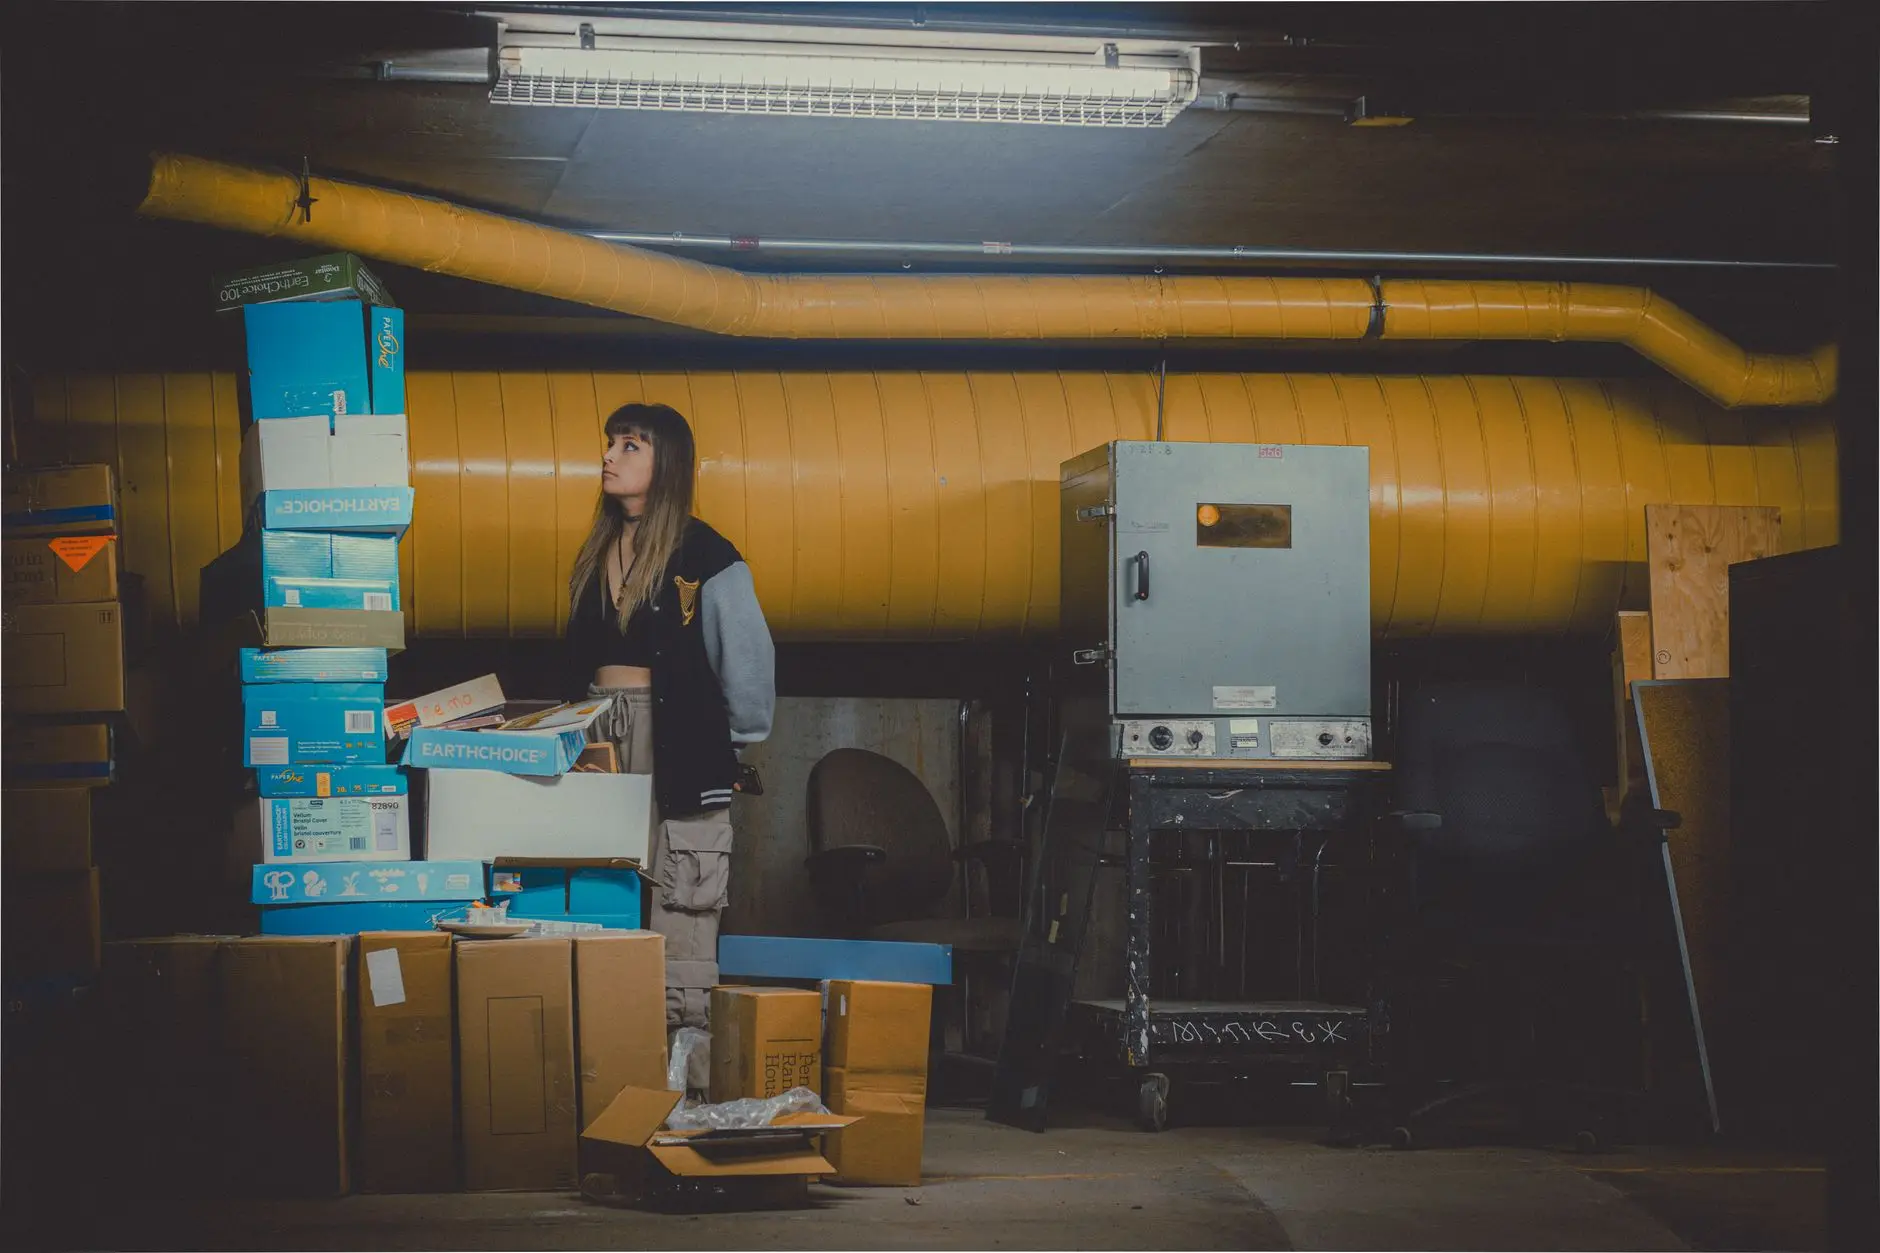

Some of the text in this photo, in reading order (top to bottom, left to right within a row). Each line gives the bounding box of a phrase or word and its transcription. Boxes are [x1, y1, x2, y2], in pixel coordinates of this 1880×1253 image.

[220, 289, 241, 302] 100
[242, 275, 310, 297] EarthChoice
[382, 316, 392, 348] PAPER
[282, 497, 401, 515] EARTHCHOICE
[422, 743, 539, 764] EARTHCHOICE
[371, 802, 399, 810] 82890
[782, 1052, 797, 1094] Ran
